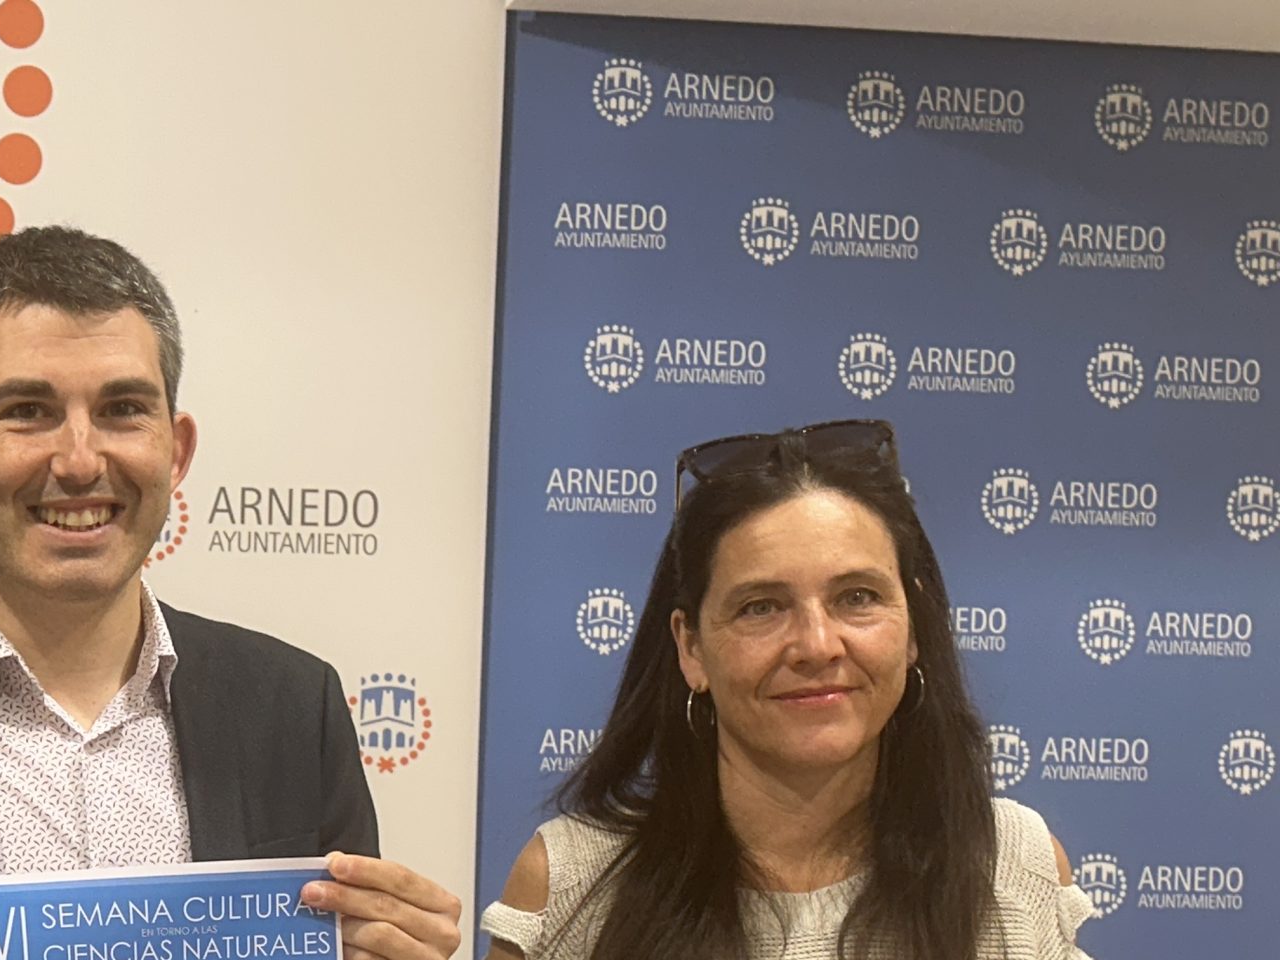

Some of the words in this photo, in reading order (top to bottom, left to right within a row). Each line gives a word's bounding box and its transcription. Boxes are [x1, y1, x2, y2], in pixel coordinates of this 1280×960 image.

[664, 72, 774, 104] ARNEDO
[917, 85, 1024, 116] ARNEDO
[664, 101, 774, 122] AYUNTAMIENTO
[1163, 98, 1269, 129] ARNEDO
[917, 115, 1024, 134] AYUNTAMIENTO
[1163, 128, 1269, 147] AYUNTAMIENTO
[554, 202, 666, 232] ARNEDO
[811, 213, 919, 242] ARNEDO
[554, 230, 666, 249] AYUNTAMIENTO
[811, 241, 919, 260] AYUNTAMIENTO
[1059, 224, 1166, 253] ARNEDO
[1059, 252, 1166, 271] AYUNTAMIENTO
[655, 339, 766, 367] ARNEDO
[908, 347, 1015, 376] ARNEDO
[655, 366, 766, 386] AYUNTAMIENTO
[1154, 356, 1261, 385] ARNEDO
[908, 375, 1015, 394] AYUNTAMIENTO
[1154, 384, 1261, 403] AYUNTAMIENTO
[546, 468, 657, 496] ARNEDO
[208, 486, 379, 527] ARNEDO
[546, 495, 657, 514] AYUNTAMIENTO
[1050, 482, 1157, 510] ARNEDO
[1050, 508, 1157, 528] AYUNTAMIENTO
[208, 531, 377, 555] AYUNTAMIENTO
[1146, 612, 1252, 639] ARNEDO
[1146, 640, 1251, 656] AYUNTAMIENTO
[1041, 737, 1148, 764] ARNEDO
[1041, 765, 1148, 781] AYUNTAMIENTO
[1138, 866, 1243, 892] ARNEDO
[41, 897, 173, 930] SEMANA
[183, 888, 328, 922] CULTURA
[1138, 893, 1243, 909] AYUNTAMIENTO
[141, 928, 154, 937] EN
[156, 926, 189, 936] TORNO
[191, 925, 198, 934] A
[200, 924, 217, 934] LAS
